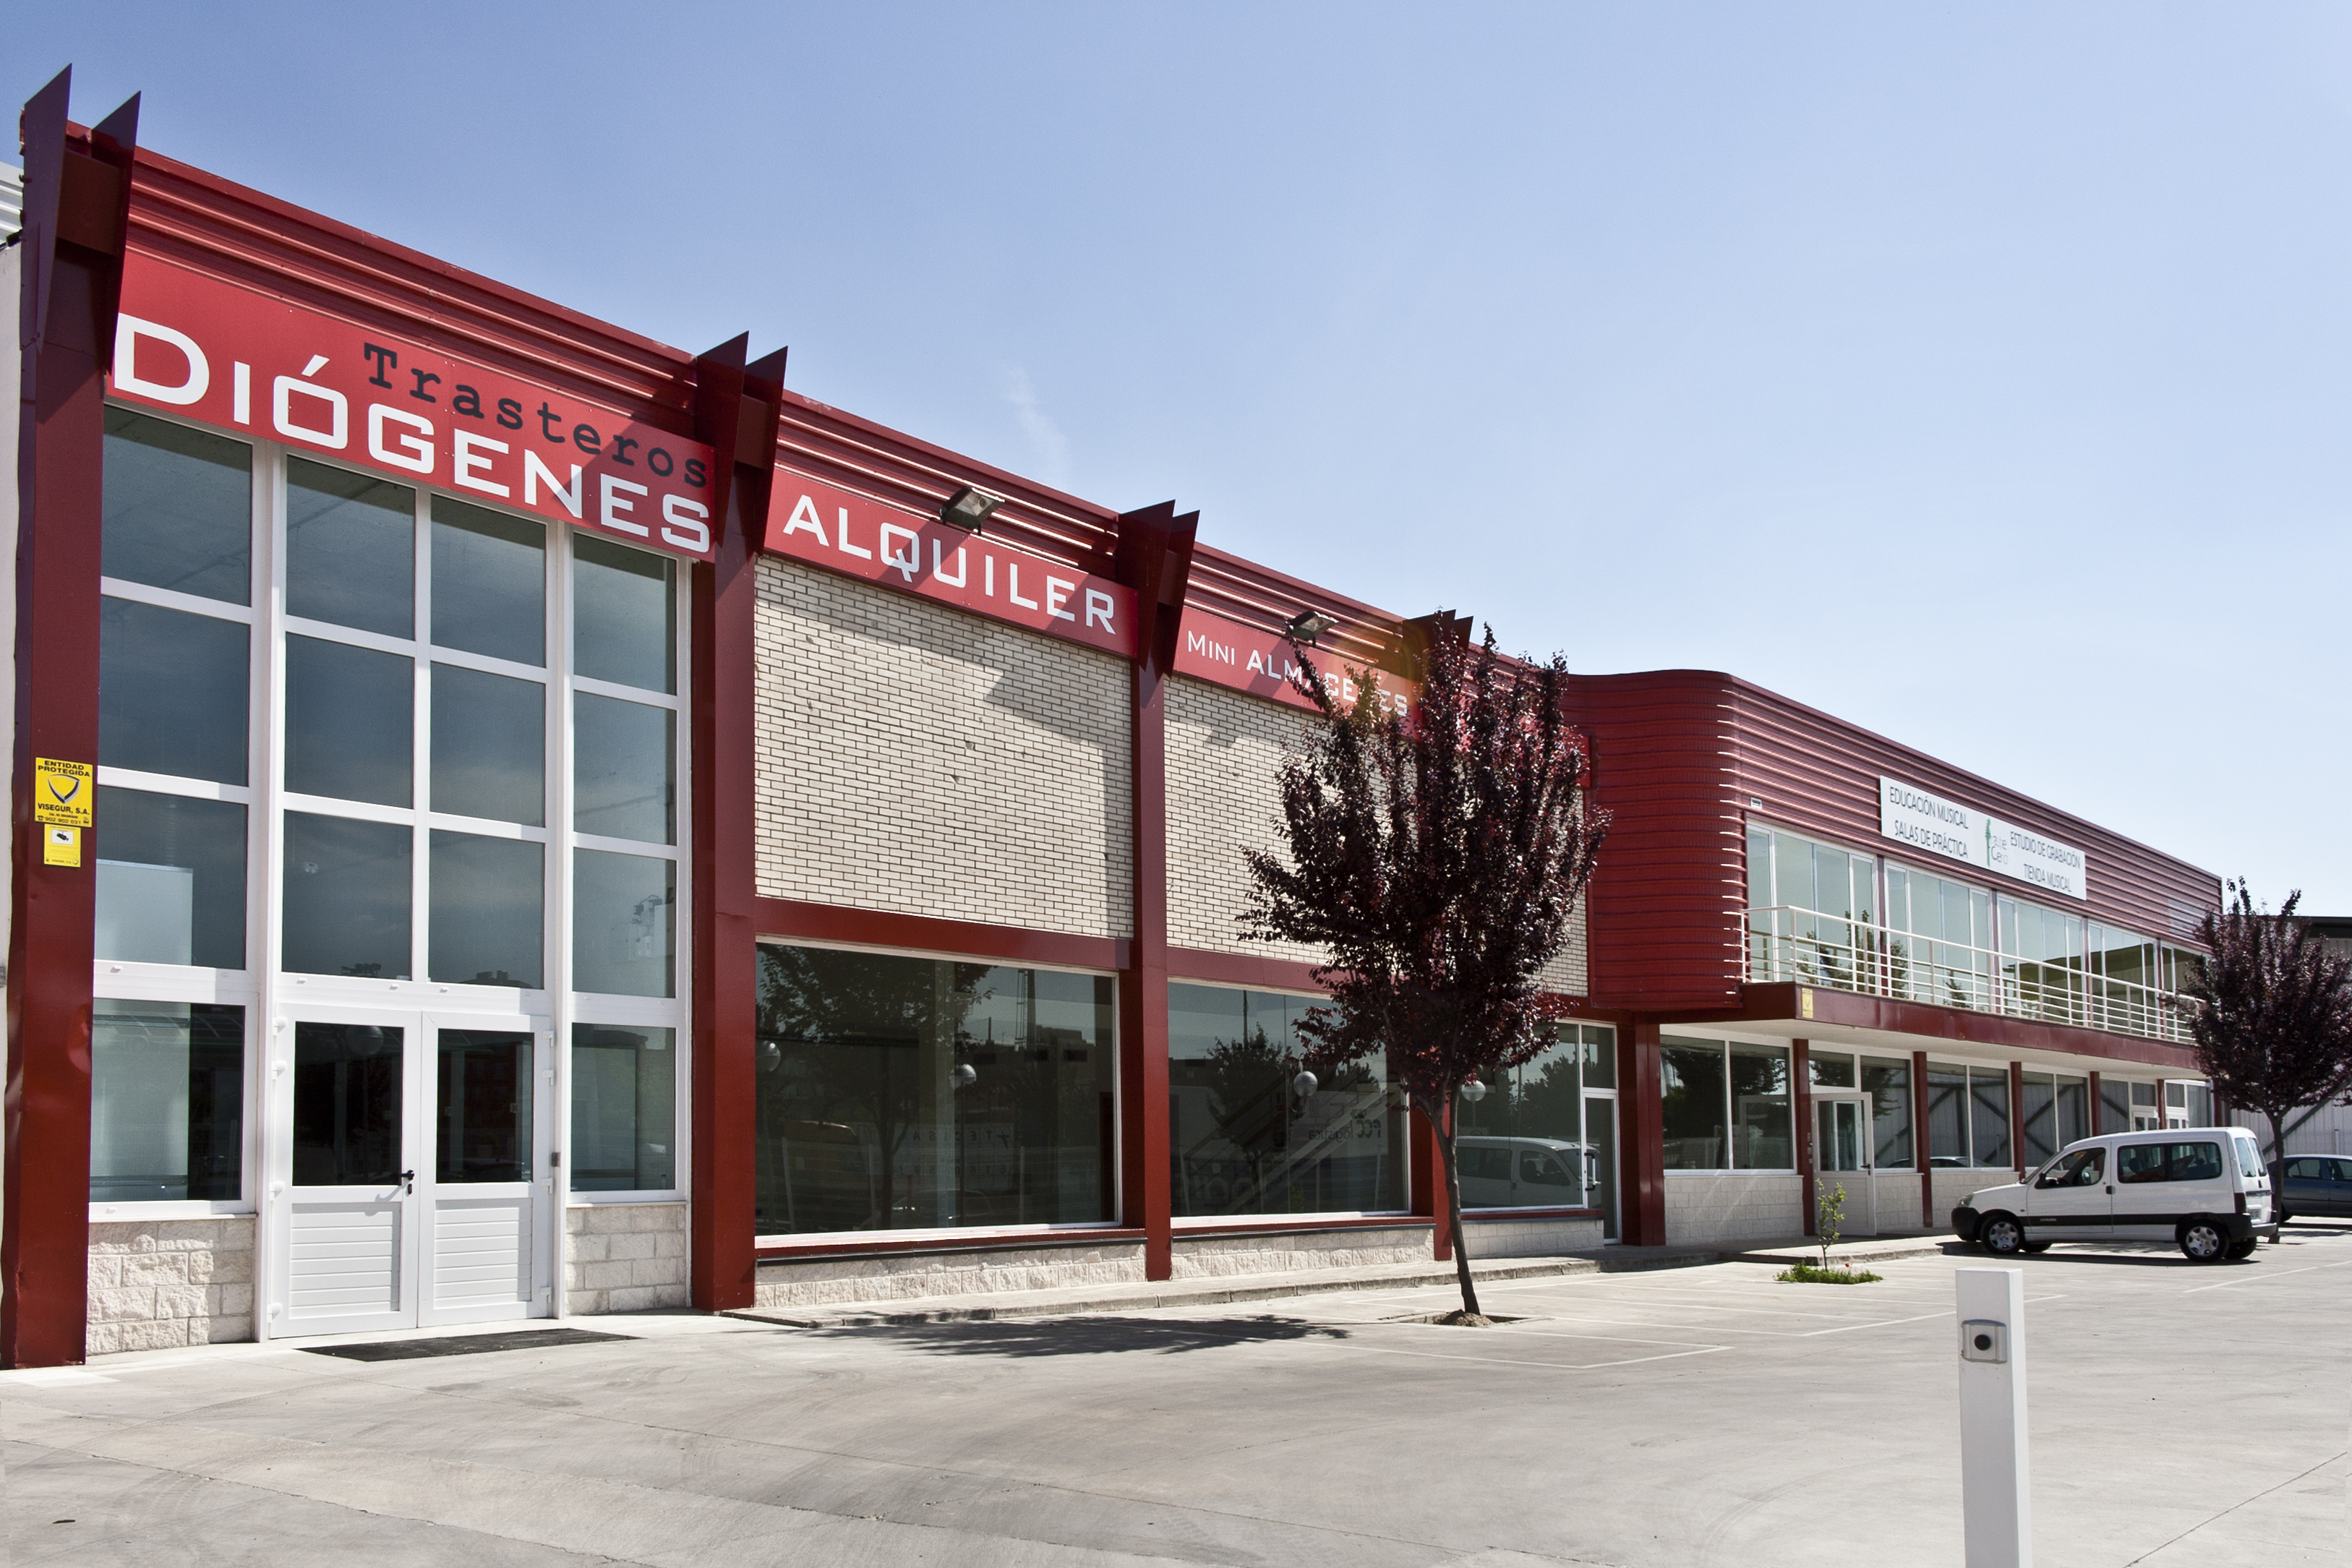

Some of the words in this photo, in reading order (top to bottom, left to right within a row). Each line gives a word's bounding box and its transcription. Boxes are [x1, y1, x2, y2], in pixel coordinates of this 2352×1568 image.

[113, 311, 711, 554] DIÓGENES
[363, 342, 708, 489] Trasteros
[782, 494, 1116, 635] ALQUILER
[1246, 649, 1408, 717] ALMCEES
[38, 765, 90, 777] PROTEGIDA
[44, 760, 85, 771] ENTIDAD
[38, 802, 74, 814] VISEGUR,
[76, 807, 90, 815] S.A.
[1889, 786, 1936, 818] EDUCACIÓN
[1937, 803, 1969, 830] MUSICAL
[1894, 820, 1919, 842] SALAS
[1920, 828, 1930, 847] DE
[1933, 832, 1968, 859] PRÁCTICA
[2010, 831, 2036, 854] ESTUDIO
[2037, 841, 2045, 857] DE
[2046, 844, 2081, 870] GRABACIÓN
[2023, 863, 2045, 884] TIENDA
[2047, 871, 2072, 893] MUSICAL
